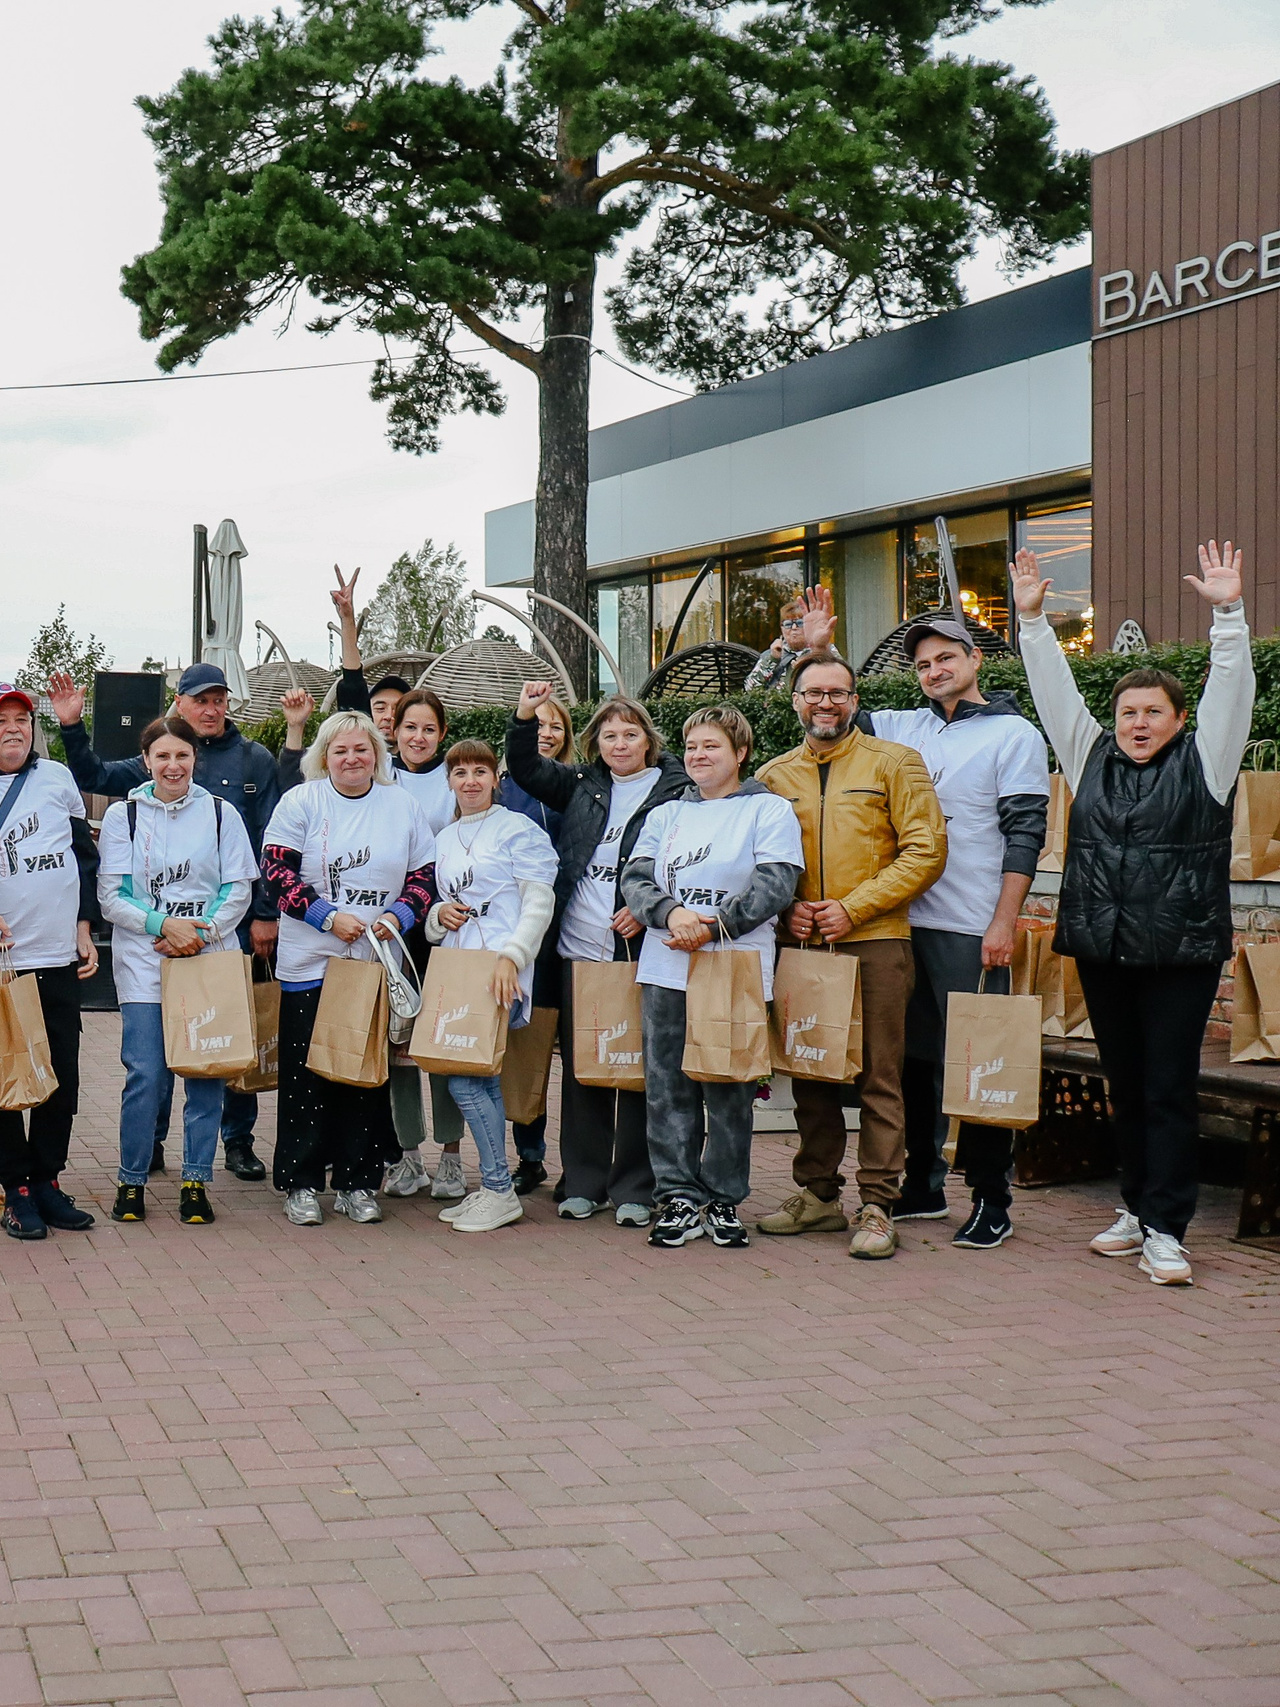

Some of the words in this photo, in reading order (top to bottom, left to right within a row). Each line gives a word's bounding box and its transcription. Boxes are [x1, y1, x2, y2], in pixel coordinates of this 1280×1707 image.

[23, 851, 66, 873] УМТ
[591, 864, 619, 883] УМ
[344, 888, 391, 907] УМТ
[678, 887, 730, 909] УМТ
[198, 1034, 234, 1051] УМТ
[444, 1033, 479, 1049] УМТ
[607, 1051, 643, 1065] УМТ
[794, 1044, 828, 1062] УМТ
[980, 1088, 1019, 1104] УМТ
